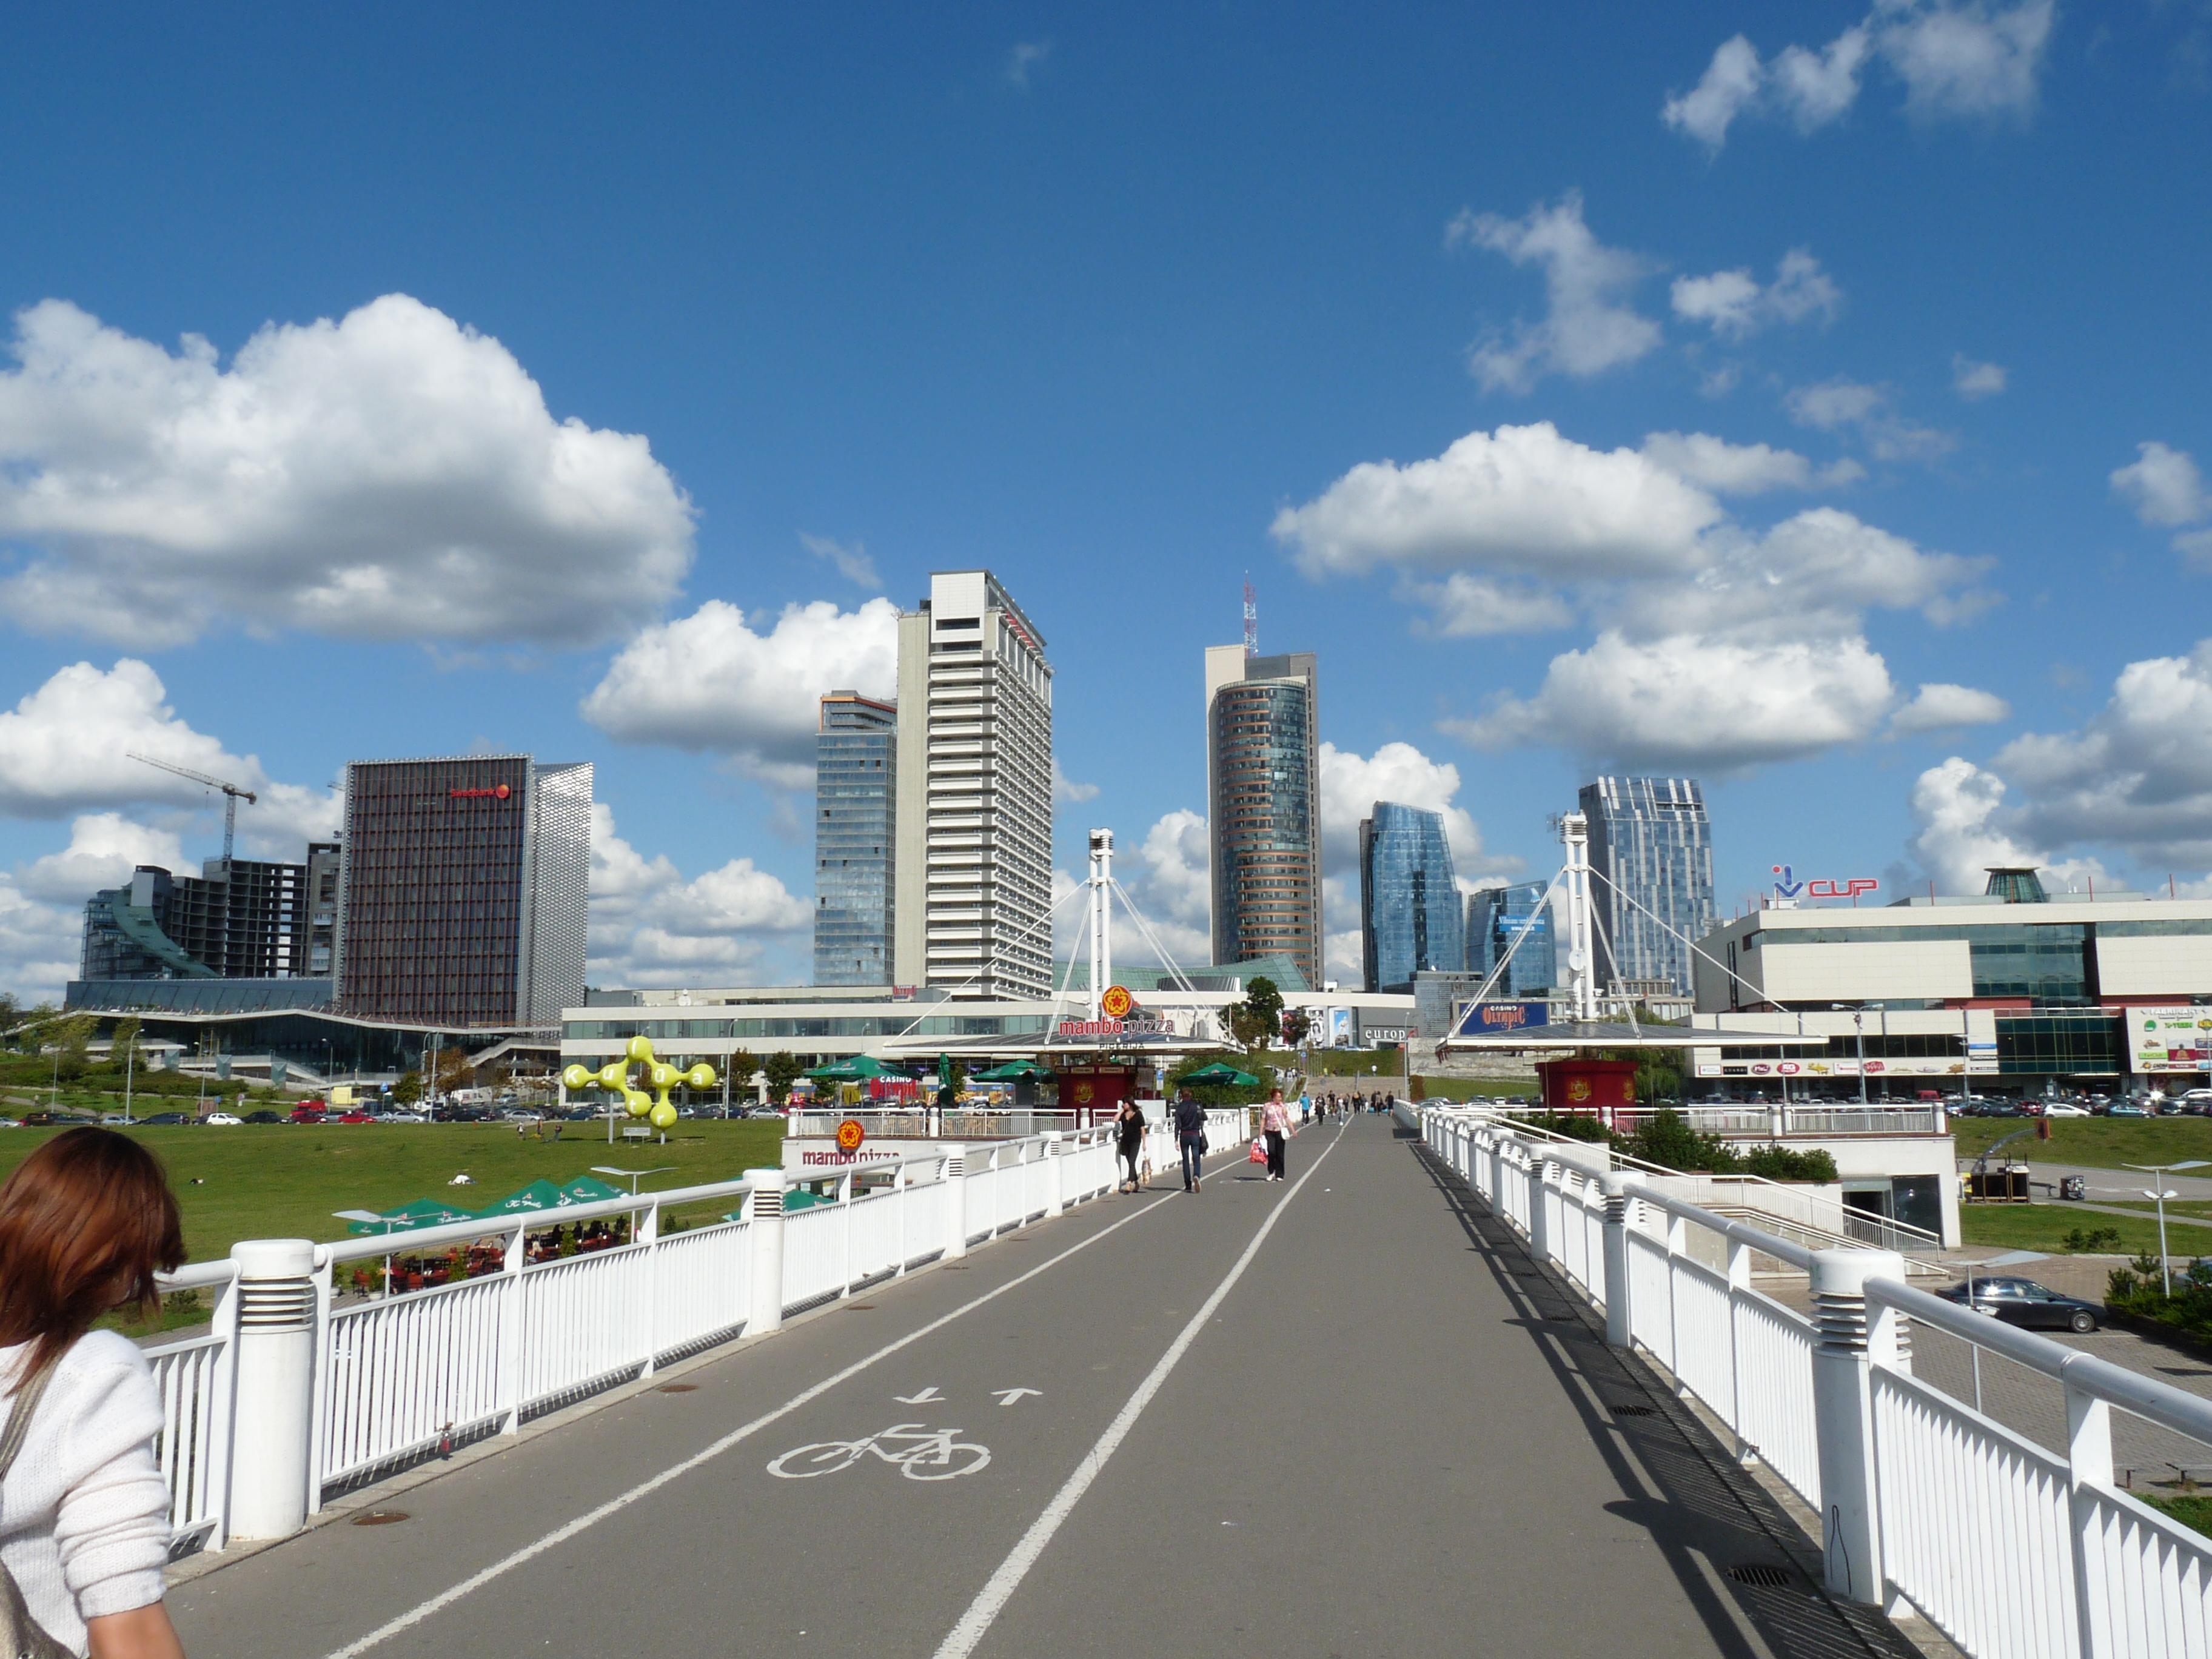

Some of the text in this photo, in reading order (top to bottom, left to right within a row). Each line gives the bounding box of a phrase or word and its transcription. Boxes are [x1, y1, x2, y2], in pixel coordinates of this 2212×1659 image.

[1809, 879, 1878, 897] CUP
[1059, 1015, 1173, 1037] mambo pizza
[803, 1147, 857, 1165] mambo
